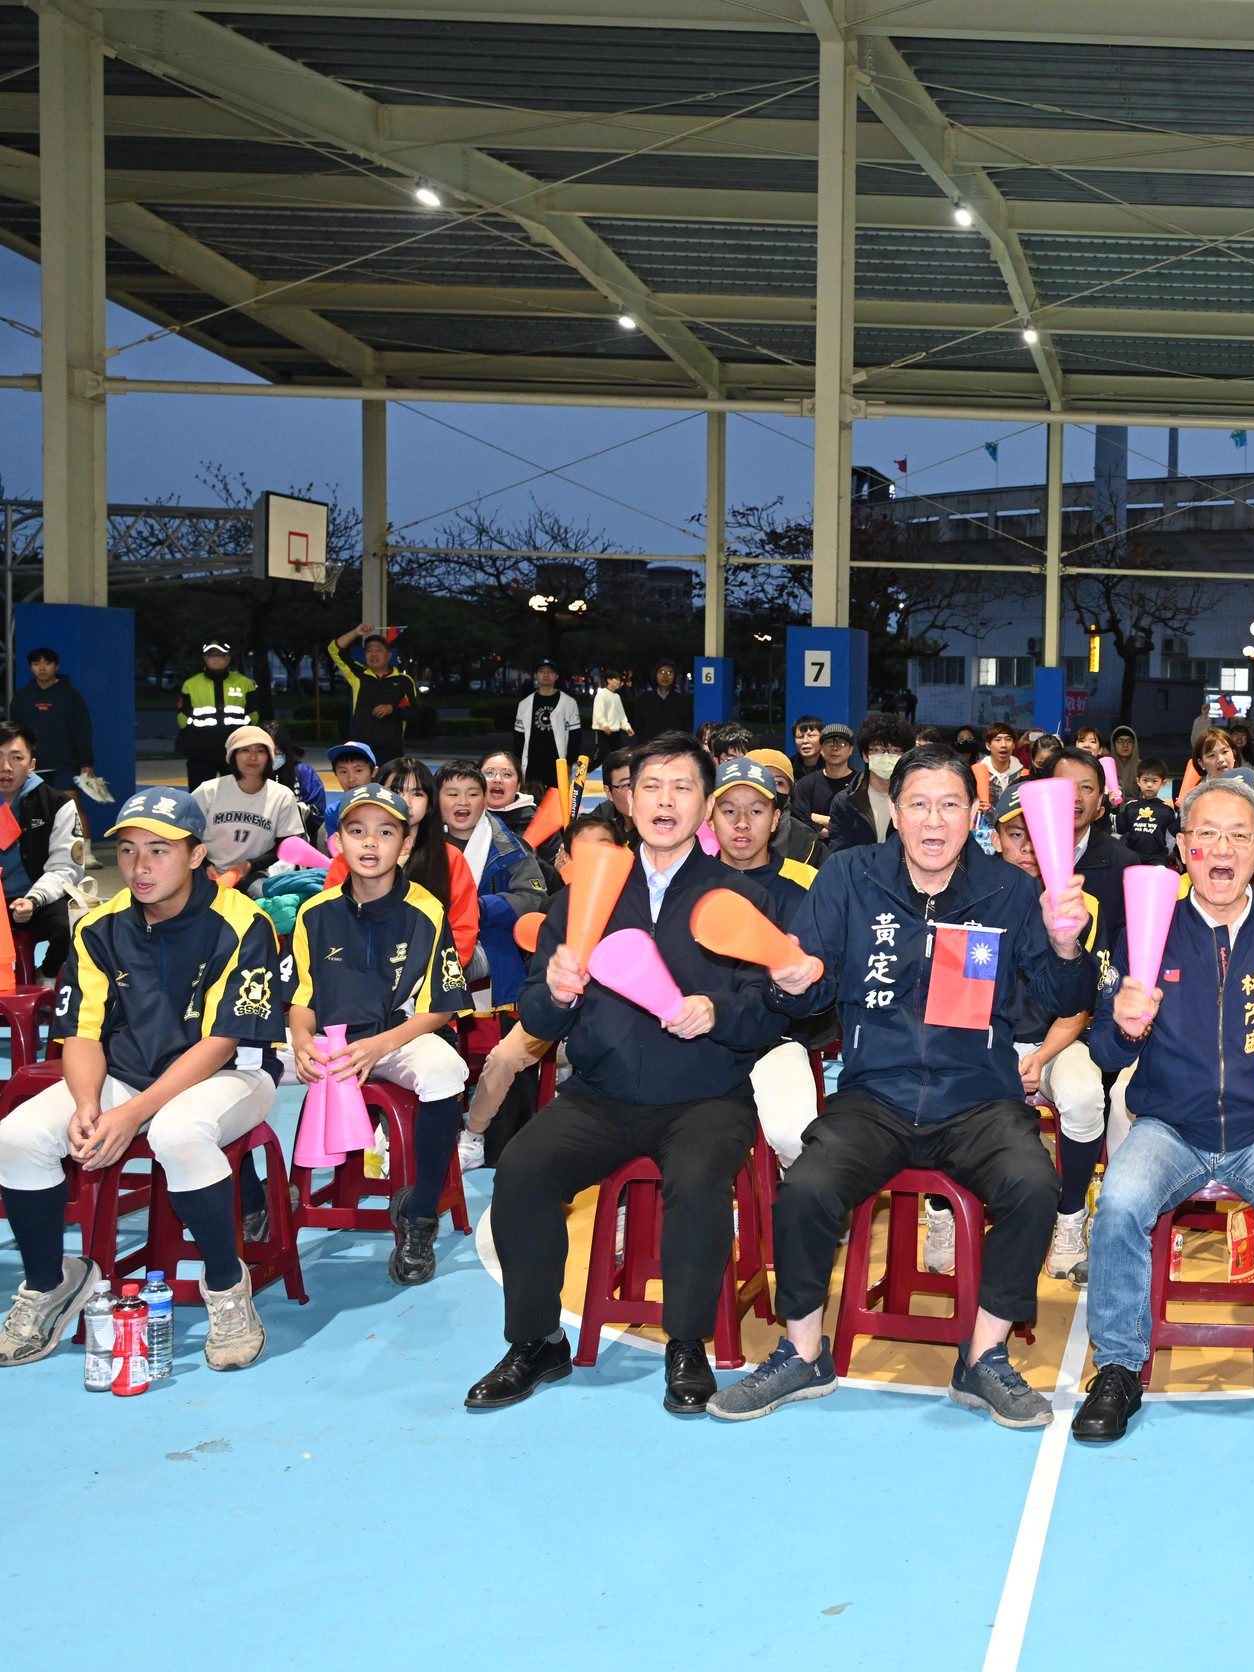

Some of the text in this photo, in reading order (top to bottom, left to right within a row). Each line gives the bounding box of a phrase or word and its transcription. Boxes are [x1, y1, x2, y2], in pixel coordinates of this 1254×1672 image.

[705, 673, 712, 682] 6
[811, 662, 825, 682] 7
[722, 764, 765, 782] 三星
[350, 787, 395, 804] 三星
[123, 796, 177, 819] 三星
[213, 810, 273, 831] MONKEYS
[233, 829, 251, 843] 17
[864, 912, 901, 1009] 黃定和
